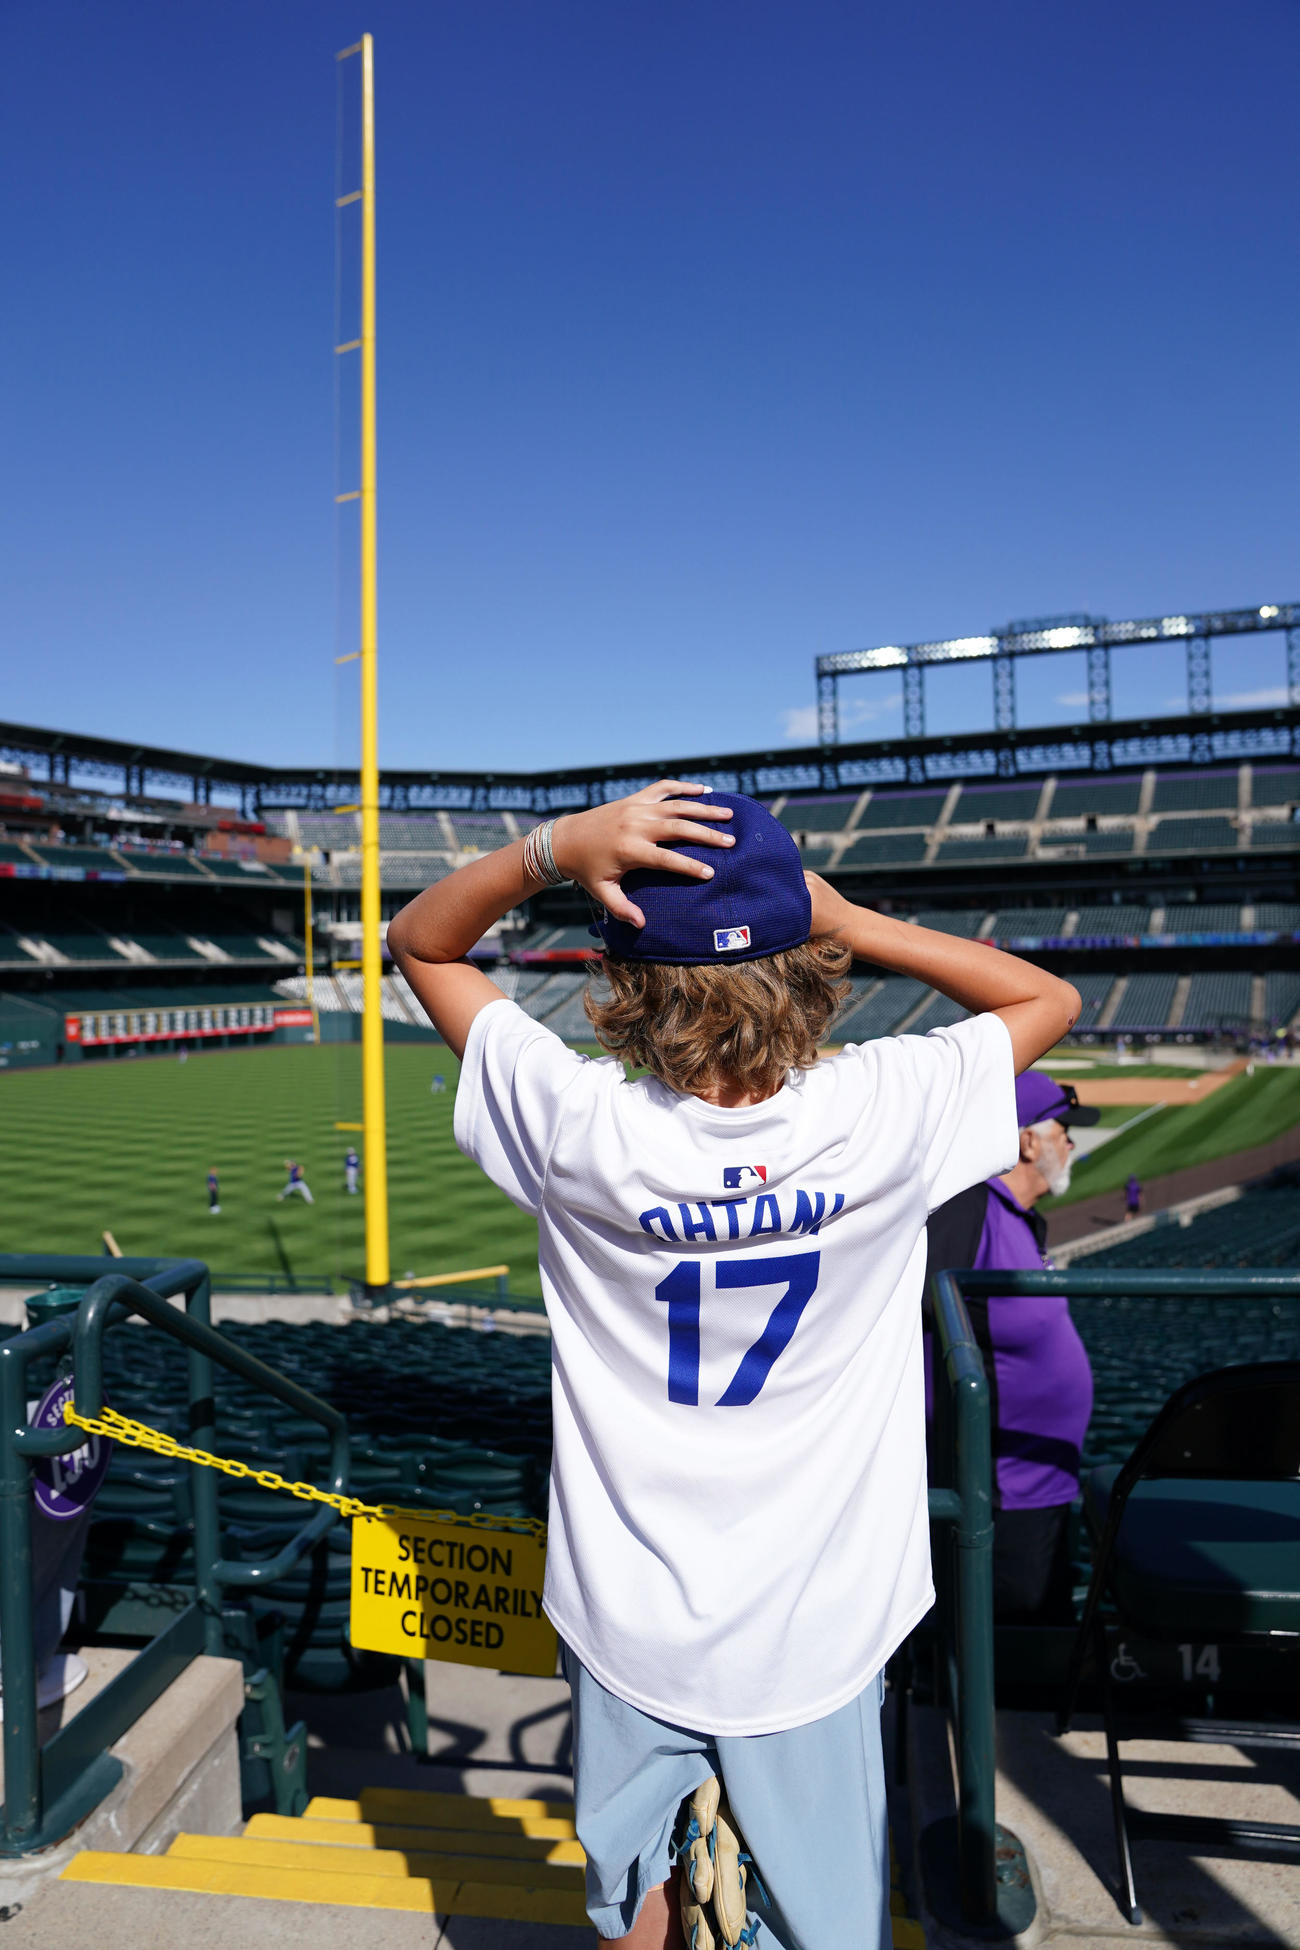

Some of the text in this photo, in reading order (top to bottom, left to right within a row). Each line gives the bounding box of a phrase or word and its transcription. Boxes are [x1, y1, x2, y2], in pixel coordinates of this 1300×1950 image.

[655, 1250, 821, 1406] 17
[398, 1534, 512, 1577] SECTION
[361, 1566, 543, 1619] TEMPORARILY
[401, 1610, 504, 1650] CLOSED
[1178, 1644, 1221, 1681] 14
